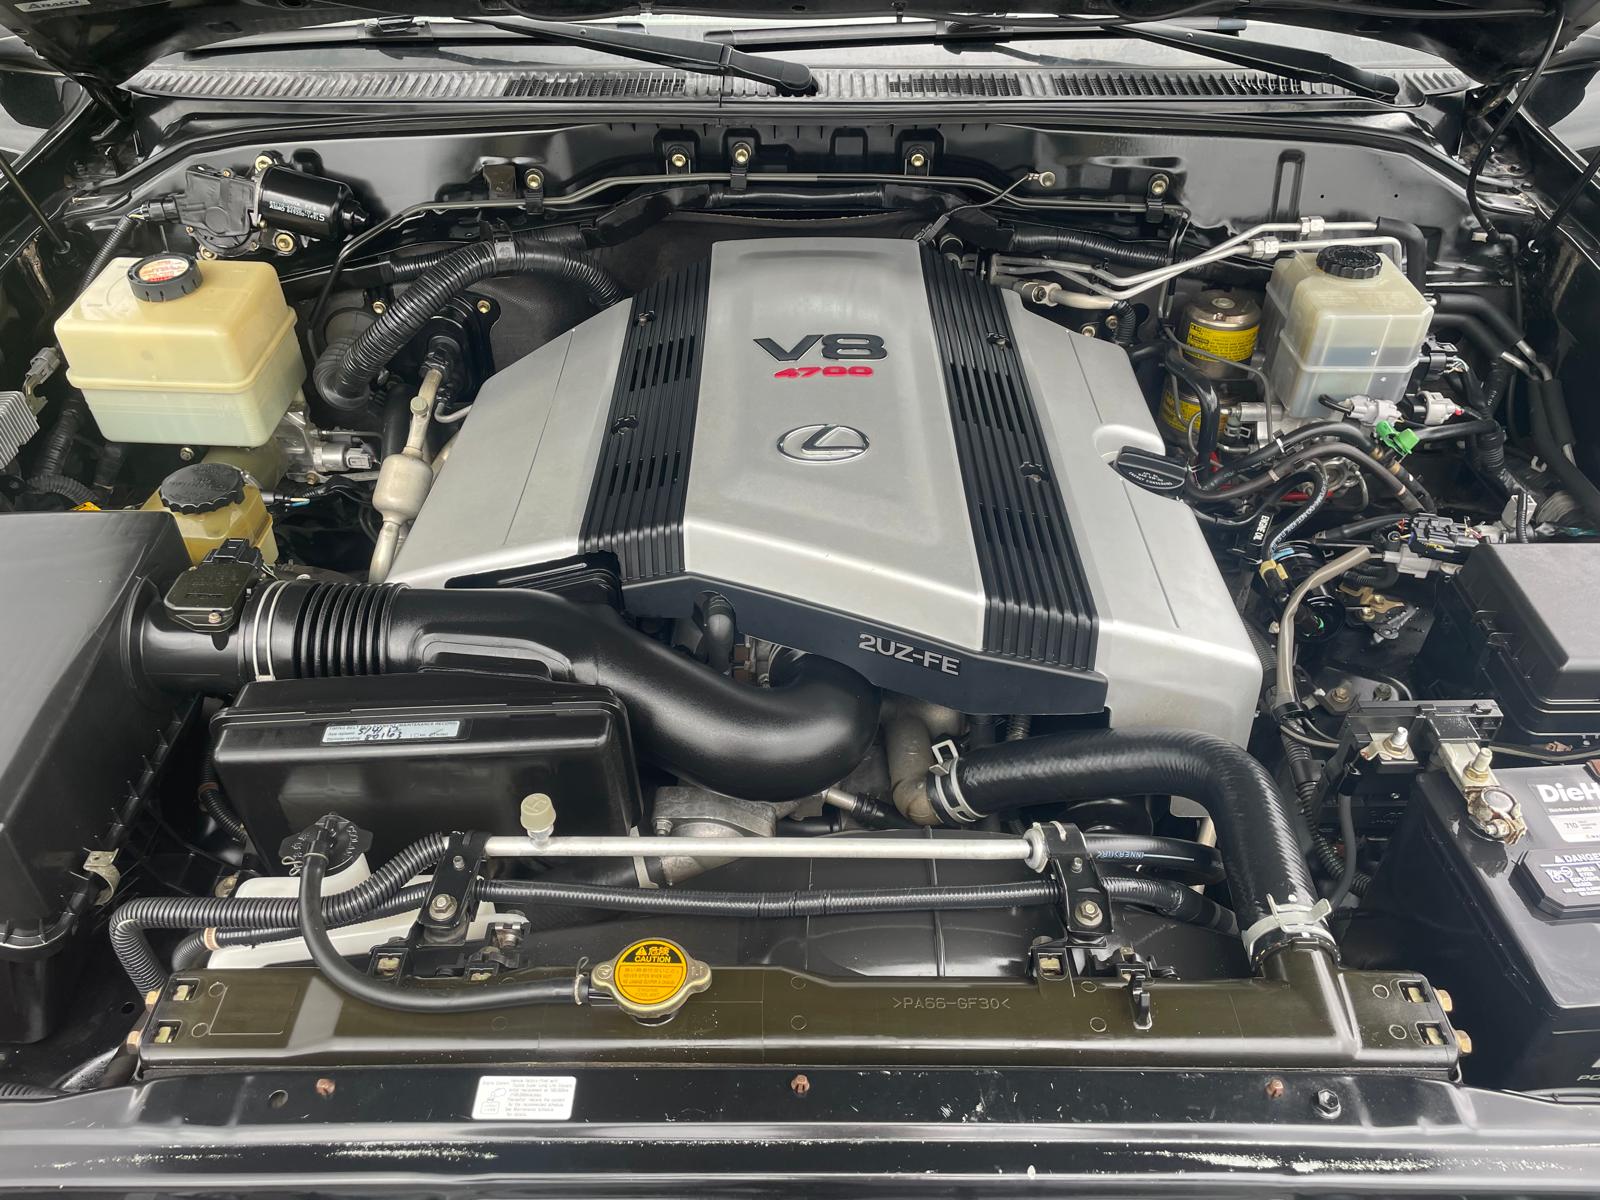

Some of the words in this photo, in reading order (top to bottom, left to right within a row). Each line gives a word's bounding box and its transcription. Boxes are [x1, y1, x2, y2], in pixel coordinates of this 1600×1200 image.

[752, 333, 888, 361] V8
[774, 366, 874, 379] 4700
[858, 633, 961, 676] 2UZ-FE
[635, 955, 671, 963] CAUTION
